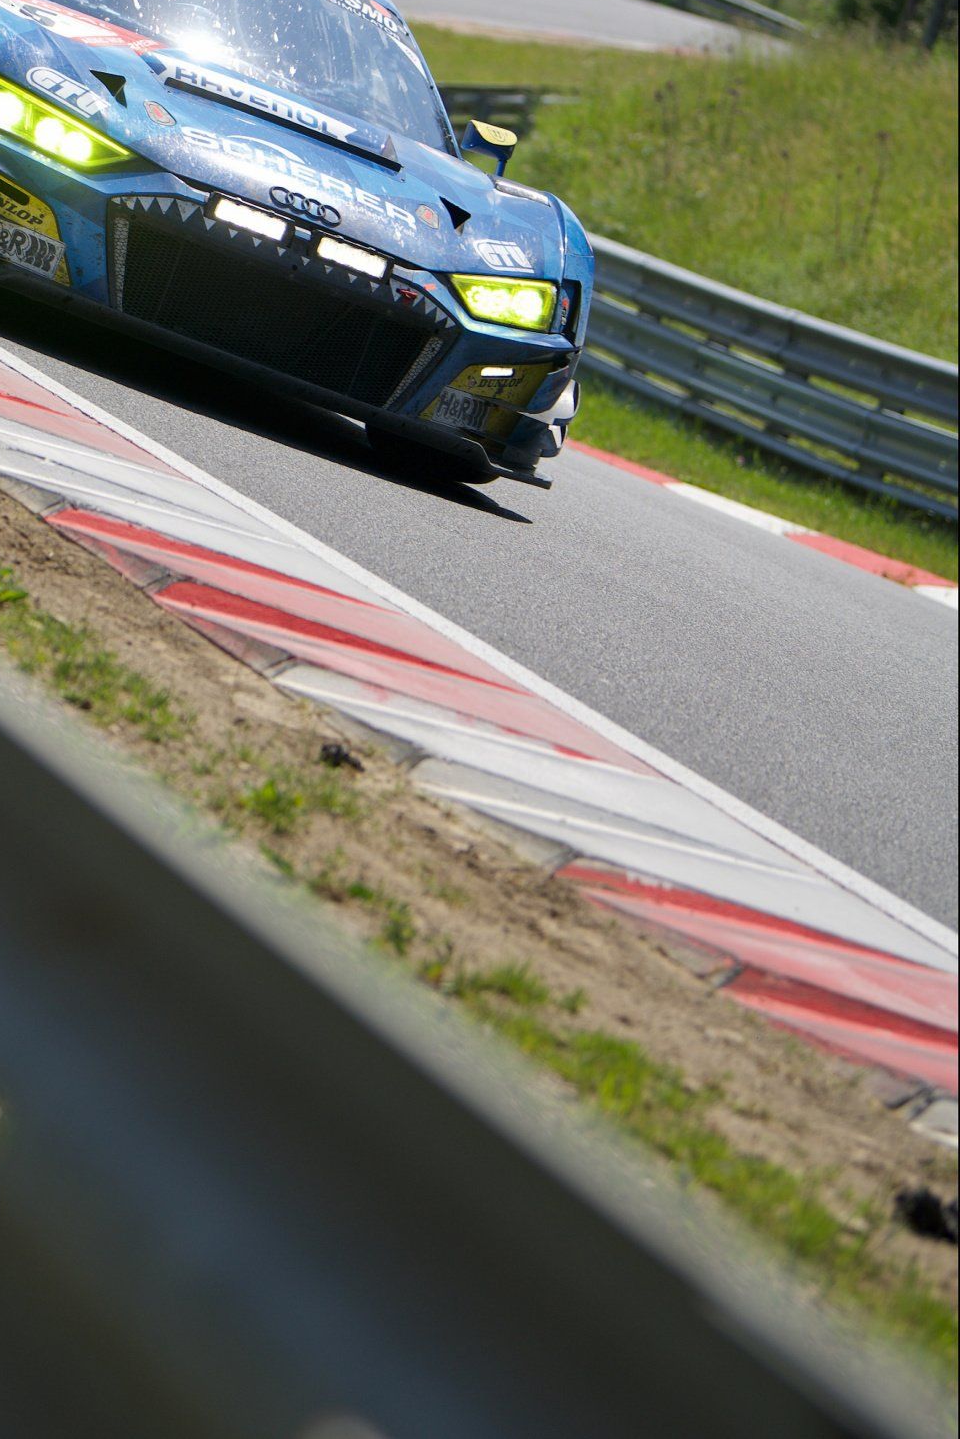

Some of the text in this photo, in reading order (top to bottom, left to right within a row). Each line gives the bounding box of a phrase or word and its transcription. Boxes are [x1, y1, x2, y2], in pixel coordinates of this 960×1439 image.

[33, 72, 108, 117] GTU
[175, 66, 344, 138] RAVENOL
[181, 126, 418, 231] SCHERER
[479, 241, 534, 269] GTU
[478, 376, 525, 389] DUNLOP
